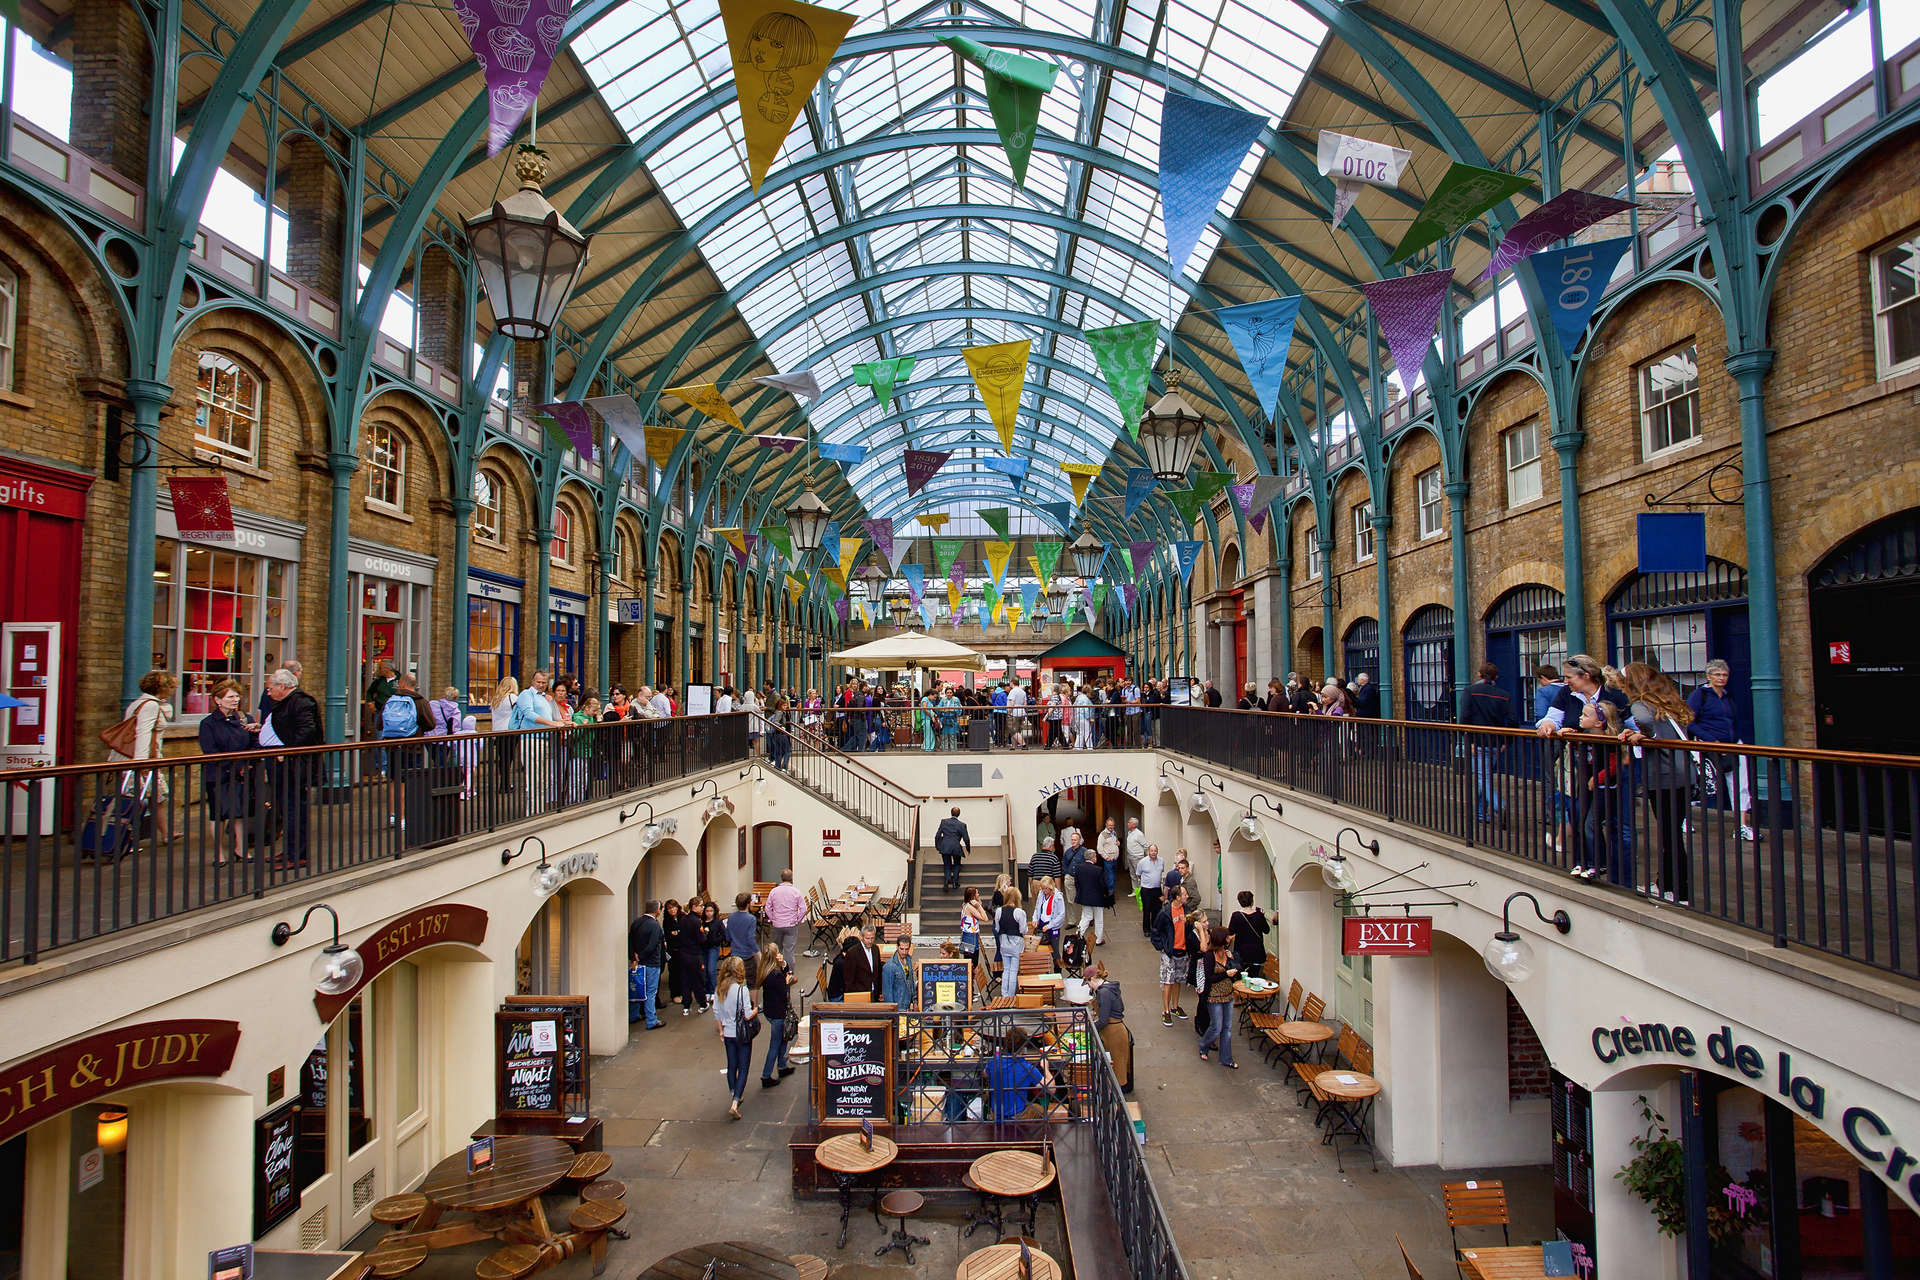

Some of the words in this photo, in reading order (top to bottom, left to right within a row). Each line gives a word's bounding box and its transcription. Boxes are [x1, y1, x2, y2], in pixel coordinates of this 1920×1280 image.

[1343, 155, 1388, 182] 2010
[1558, 250, 1594, 310] 180
[0, 480, 45, 504] gifts
[181, 531, 214, 539] REGENT
[215, 531, 233, 541] gifts
[364, 558, 412, 577] octopus
[6, 756, 34, 765] Shop
[1038, 774, 1140, 799] NAUTICALIA
[376, 922, 416, 961] EST.
[418, 913, 450, 939] 1787
[1360, 923, 1420, 941] EXIT
[506, 1031, 541, 1056] Win
[69, 1053, 103, 1089] &
[104, 1033, 211, 1088] JUDY
[1591, 1015, 1697, 1064] Crème
[1706, 1025, 1765, 1079] de
[1779, 1051, 1826, 1120] la
[511, 1066, 553, 1086] Night!
[826, 1064, 886, 1081] BREAKFAST
[841, 1084, 868, 1093] MONDAY
[836, 1096, 873, 1104] SATURDAY
